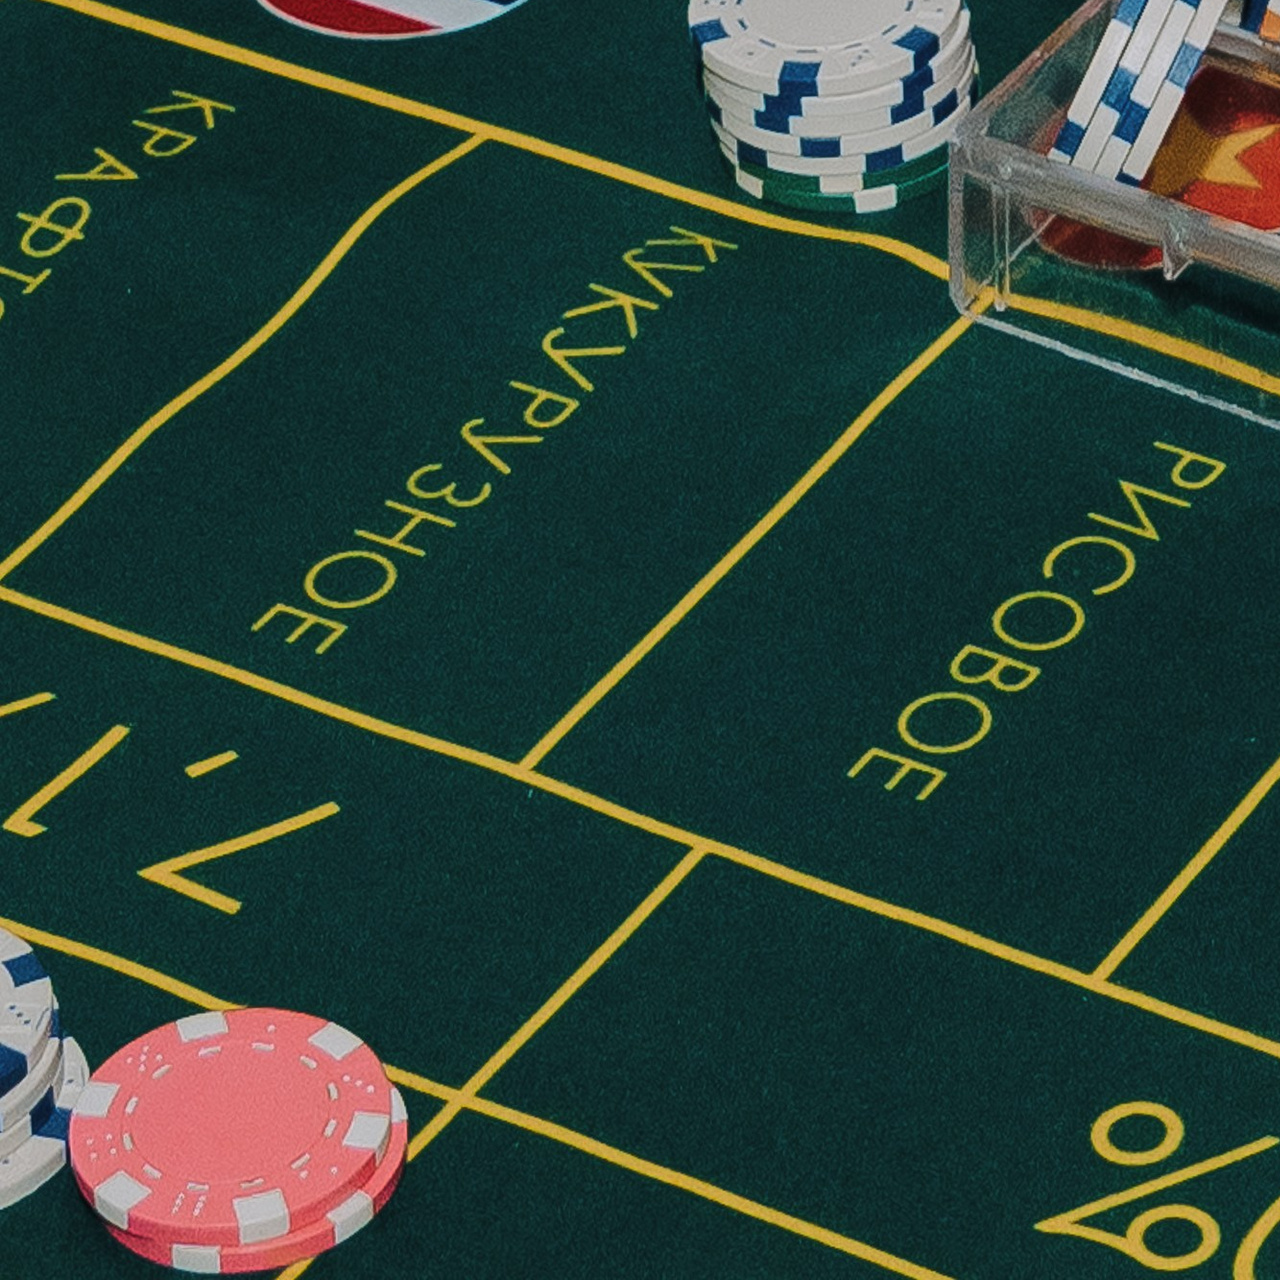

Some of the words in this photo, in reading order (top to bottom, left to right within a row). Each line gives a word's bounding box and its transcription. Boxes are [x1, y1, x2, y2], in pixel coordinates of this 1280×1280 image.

[0, 89, 236, 321] КРАФТ
[251, 225, 738, 655] КУКУРУЗНОЕ
[846, 440, 1228, 801] РИСОВОЕ
